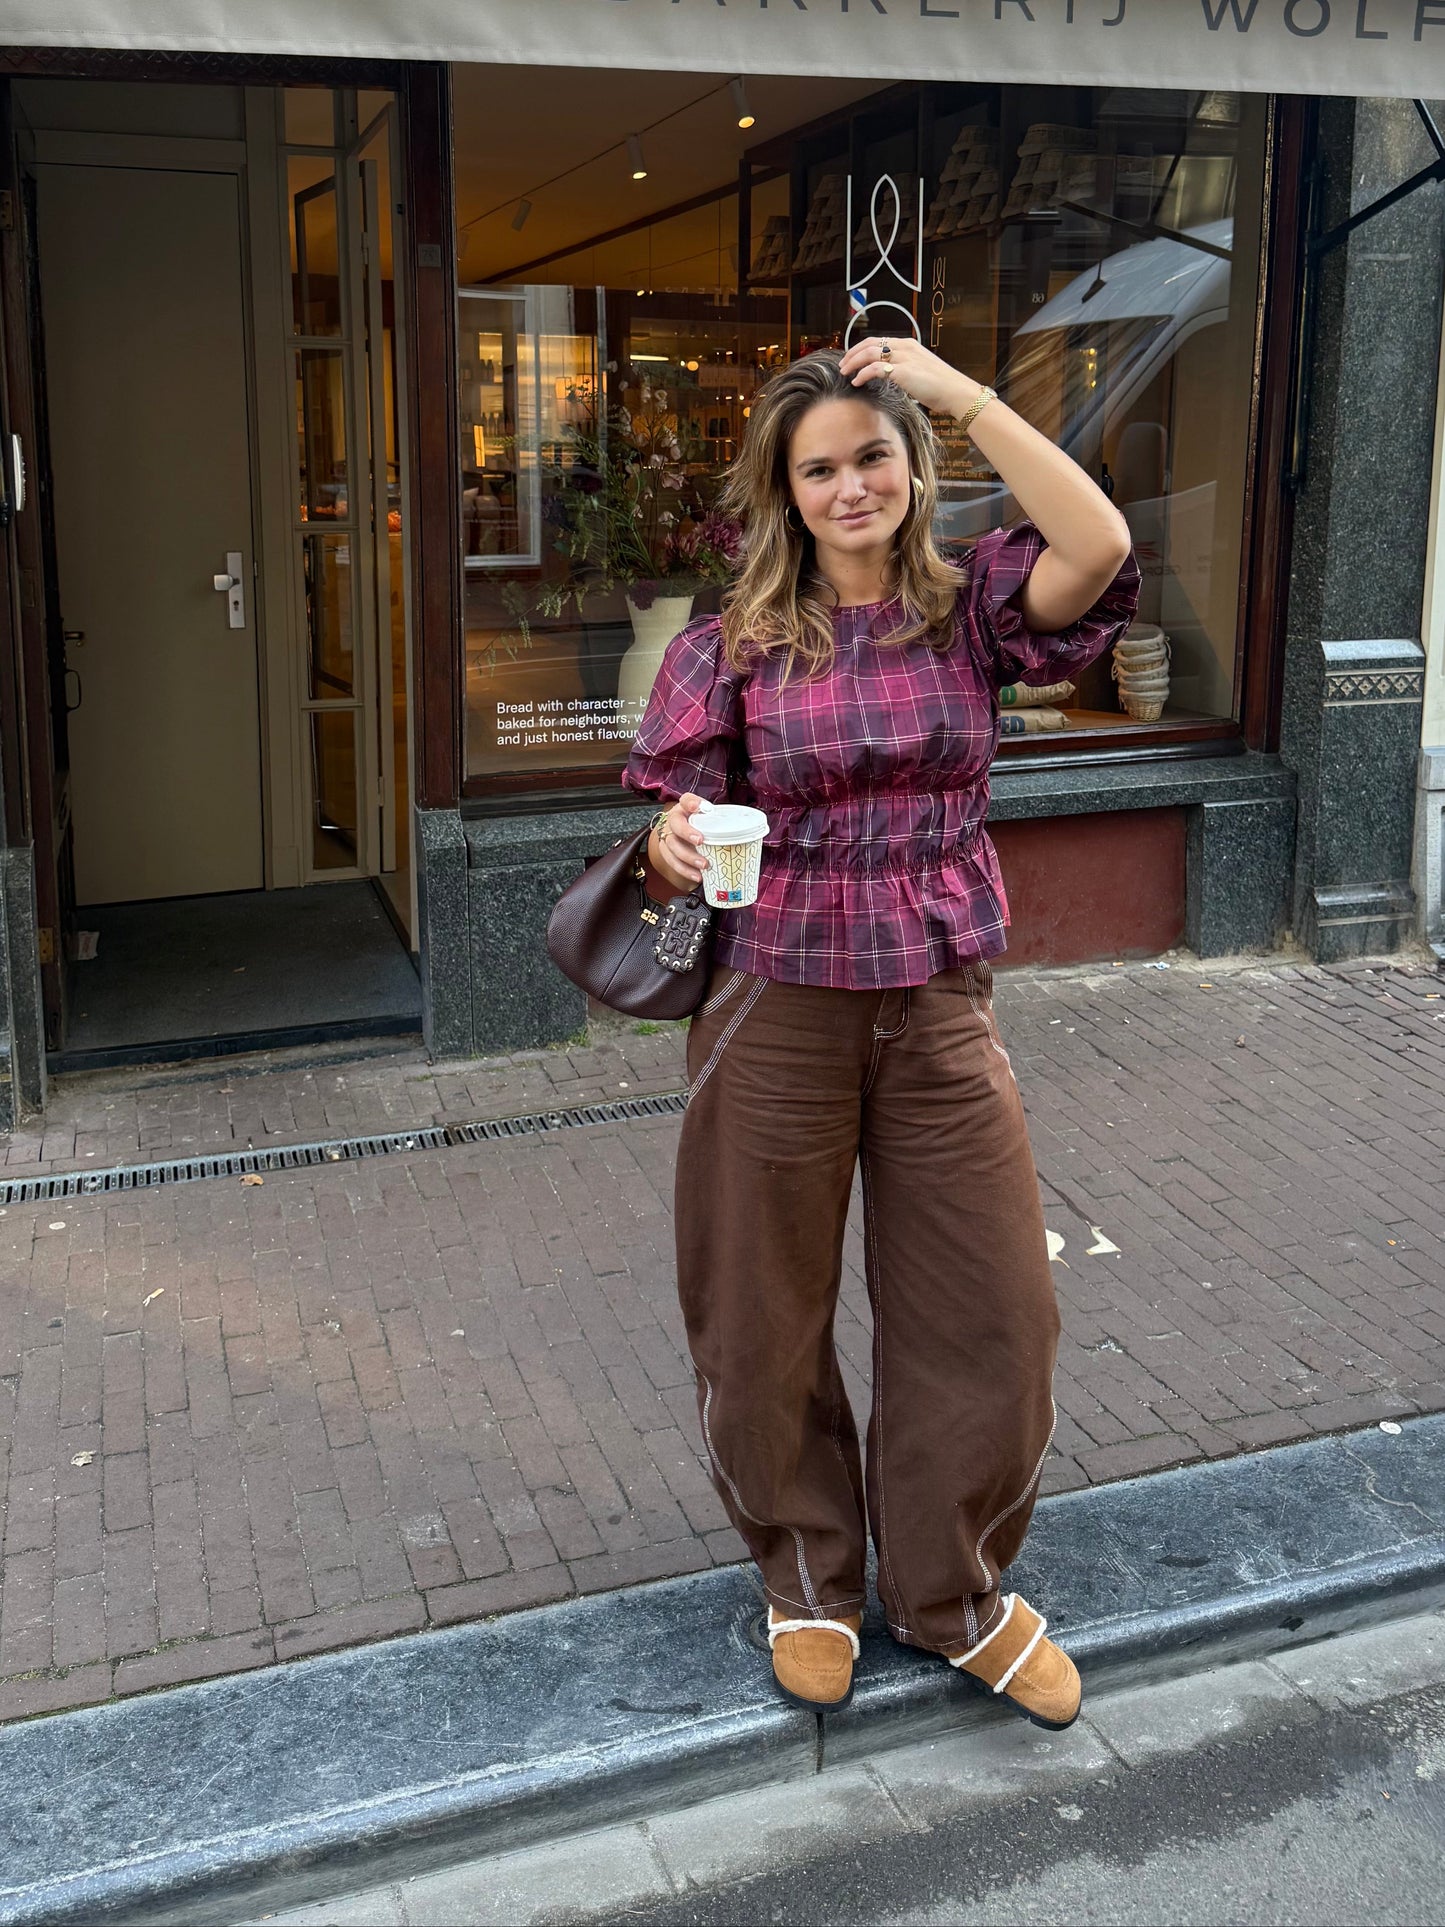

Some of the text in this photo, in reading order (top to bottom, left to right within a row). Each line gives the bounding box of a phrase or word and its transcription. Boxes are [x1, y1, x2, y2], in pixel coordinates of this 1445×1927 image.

[1201, 0, 1445, 42] WOLF
[497, 702, 533, 714] Bread
[537, 700, 564, 713] with
[567, 698, 625, 712] character
[497, 717, 535, 730] baked
[539, 716, 556, 728] for
[560, 713, 631, 729] neighbours,
[497, 733, 520, 746] and
[523, 731, 548, 747] just
[551, 730, 594, 743] honest
